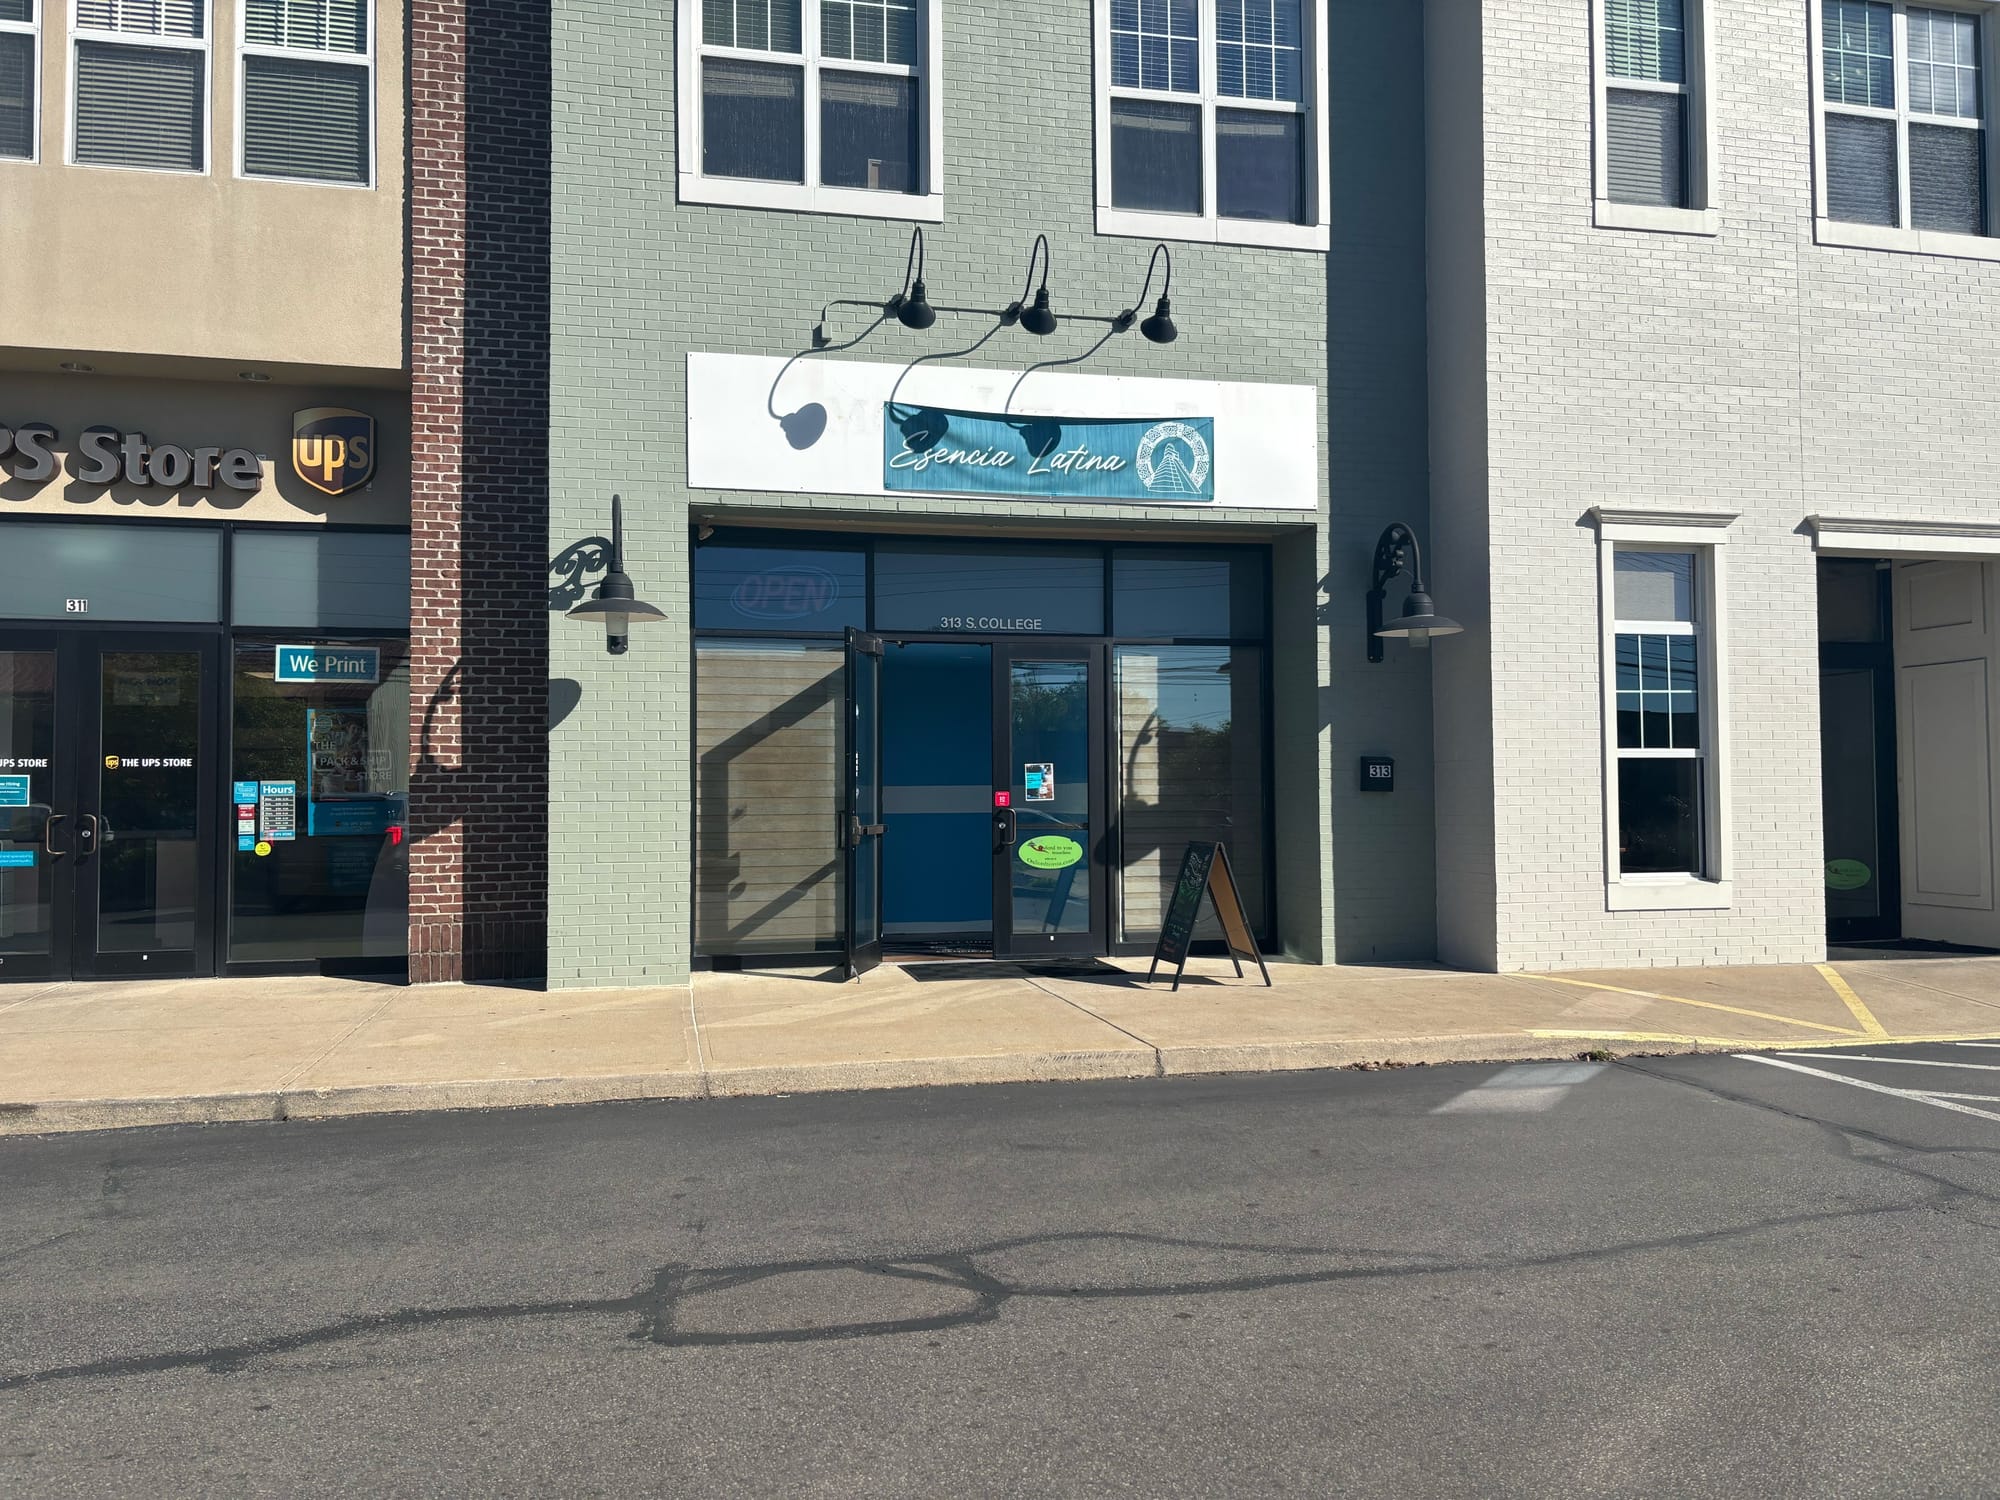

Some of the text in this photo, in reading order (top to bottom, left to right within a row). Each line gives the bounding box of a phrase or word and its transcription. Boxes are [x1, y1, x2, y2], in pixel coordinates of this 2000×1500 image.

[78, 424, 261, 490] Store
[298, 434, 368, 482] ups
[890, 431, 1127, 476] Esencia Latina
[738, 573, 829, 613] OPEN
[67, 600, 87, 612] 311
[940, 616, 962, 629] 313
[978, 616, 1042, 630] COLLEGE
[289, 654, 367, 673] We Print
[17, 759, 48, 768] STORE
[121, 759, 140, 767] THE
[142, 759, 160, 767] UPS
[163, 759, 193, 767] STORE
[320, 757, 348, 767] PACK
[356, 771, 392, 780] STORE
[1370, 766, 1390, 777] 313
[263, 785, 293, 794] Hours
